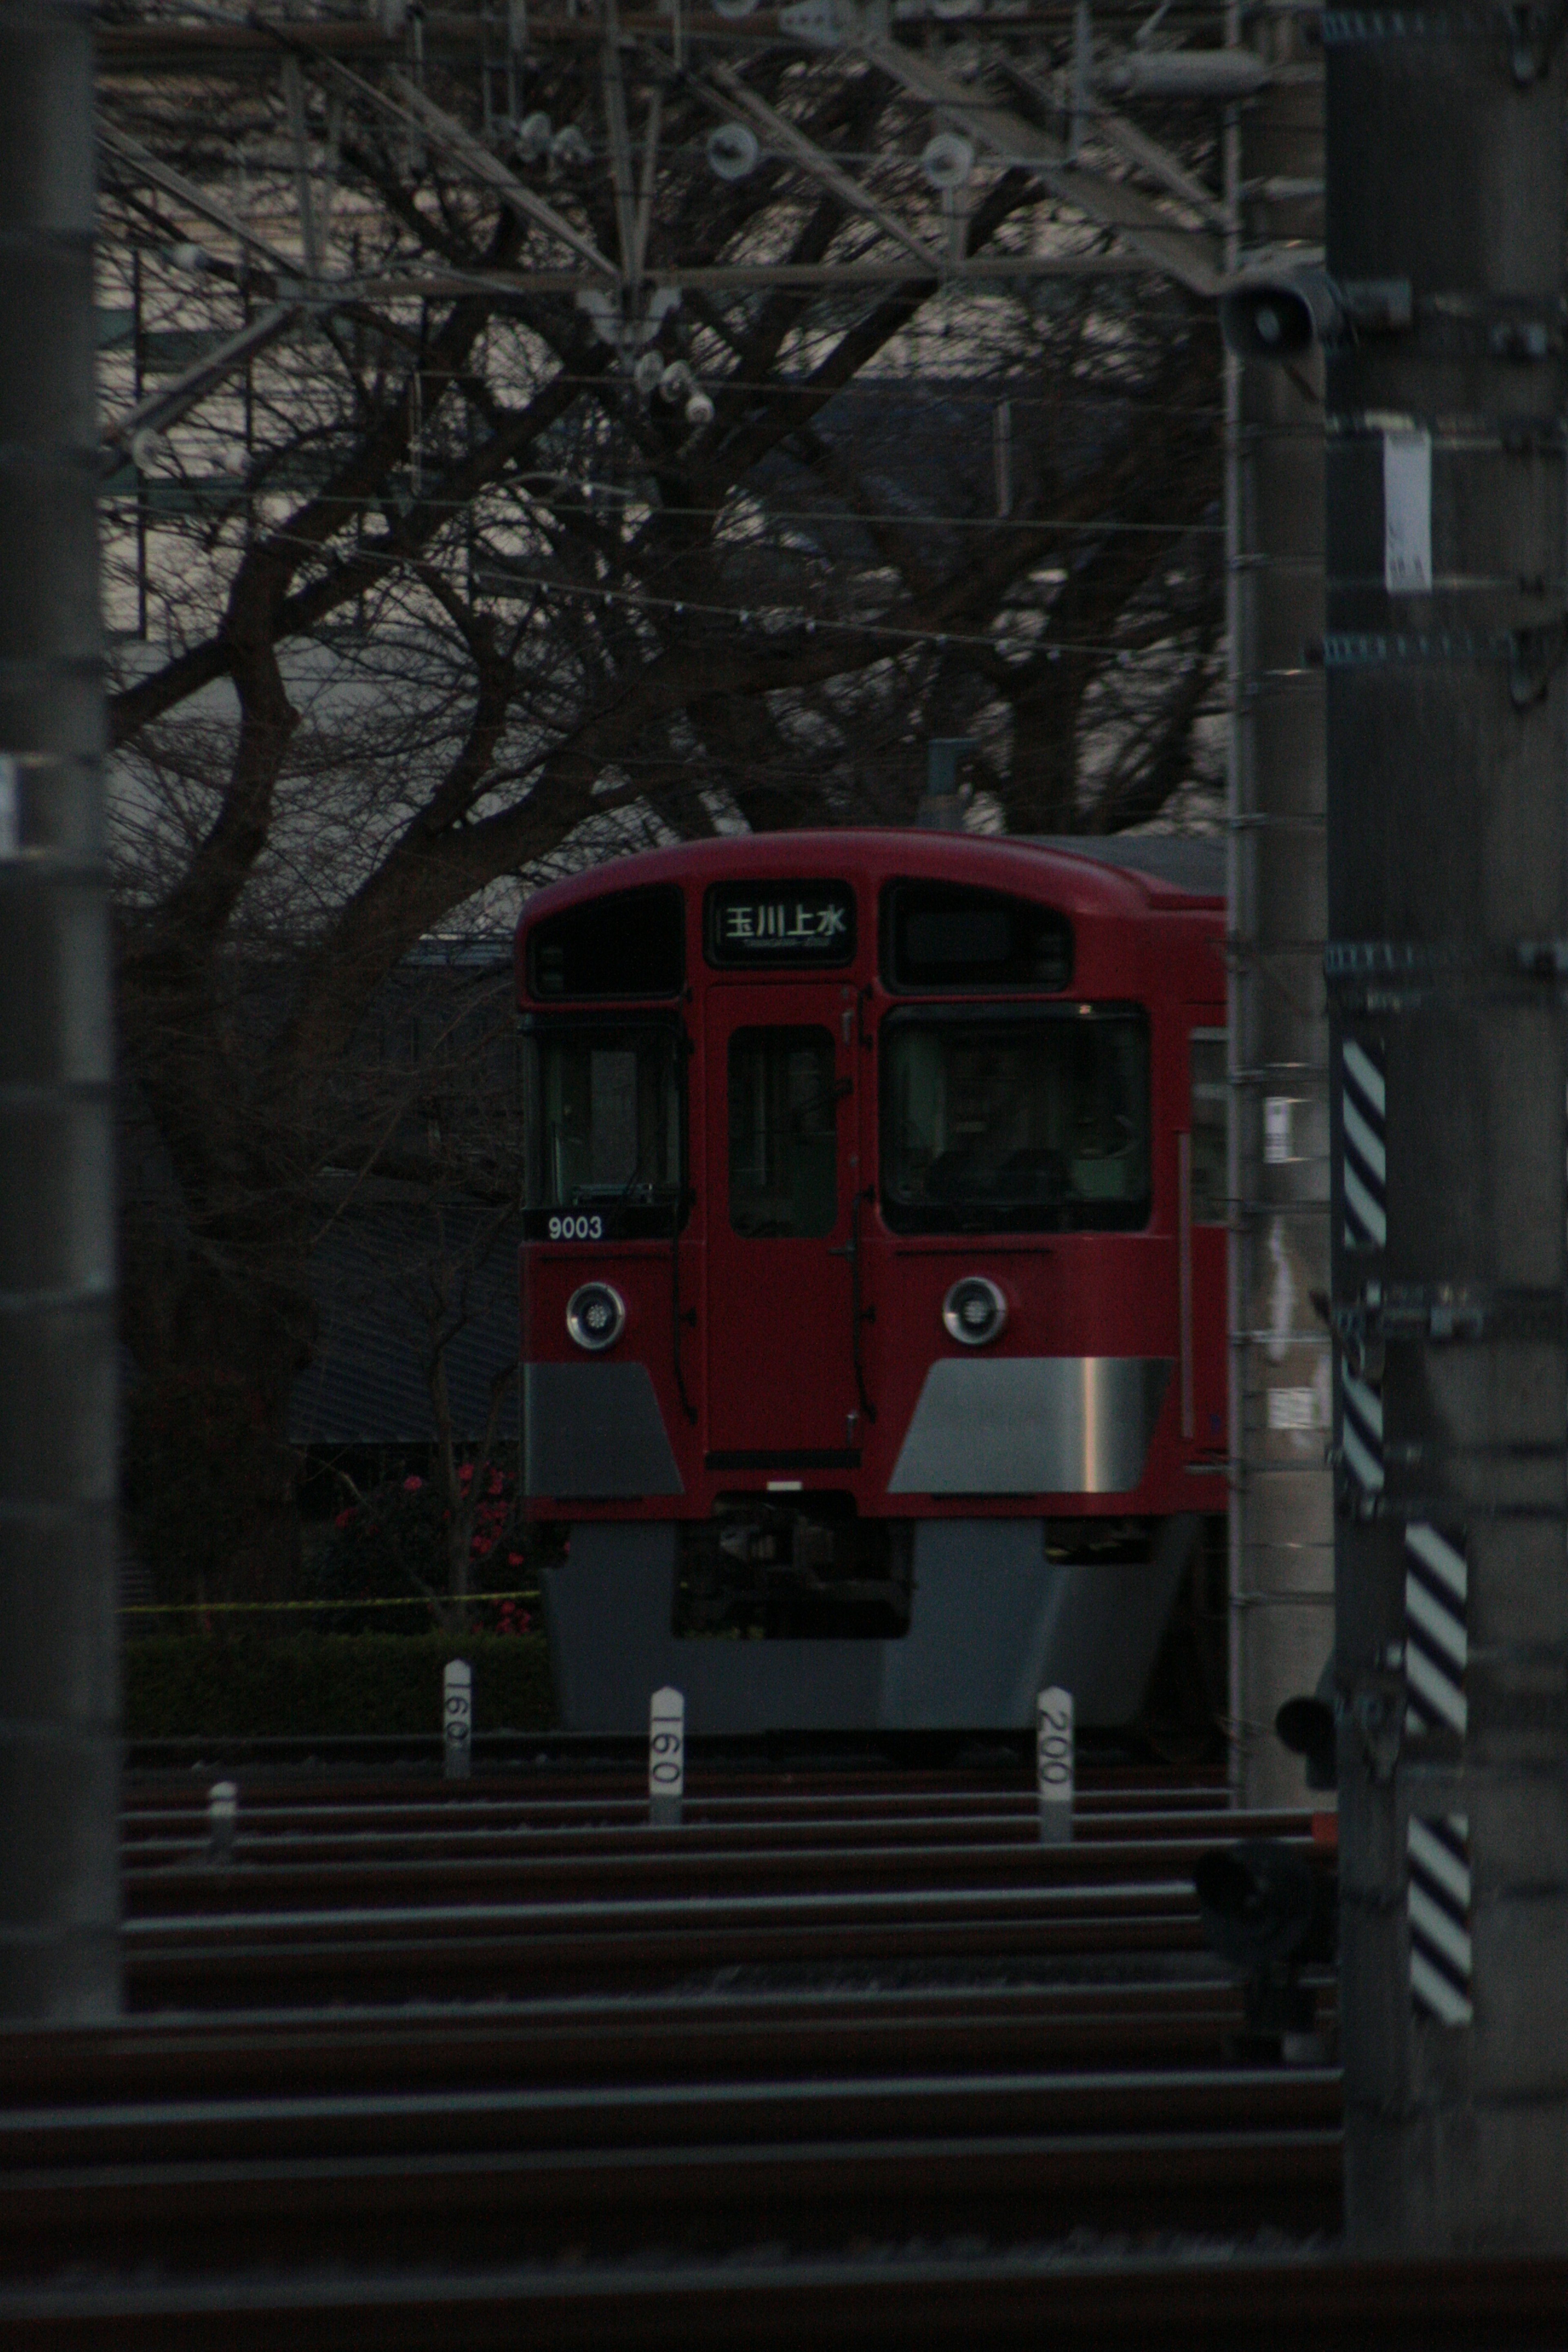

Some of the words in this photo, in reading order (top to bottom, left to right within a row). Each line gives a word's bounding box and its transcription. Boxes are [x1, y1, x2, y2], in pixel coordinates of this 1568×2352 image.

[726, 903, 847, 937] 玉川上水
[548, 1215, 602, 1240] 9003
[446, 1684, 470, 1740] 160
[653, 1717, 680, 1783] 160
[1040, 1709, 1070, 1784] 200
